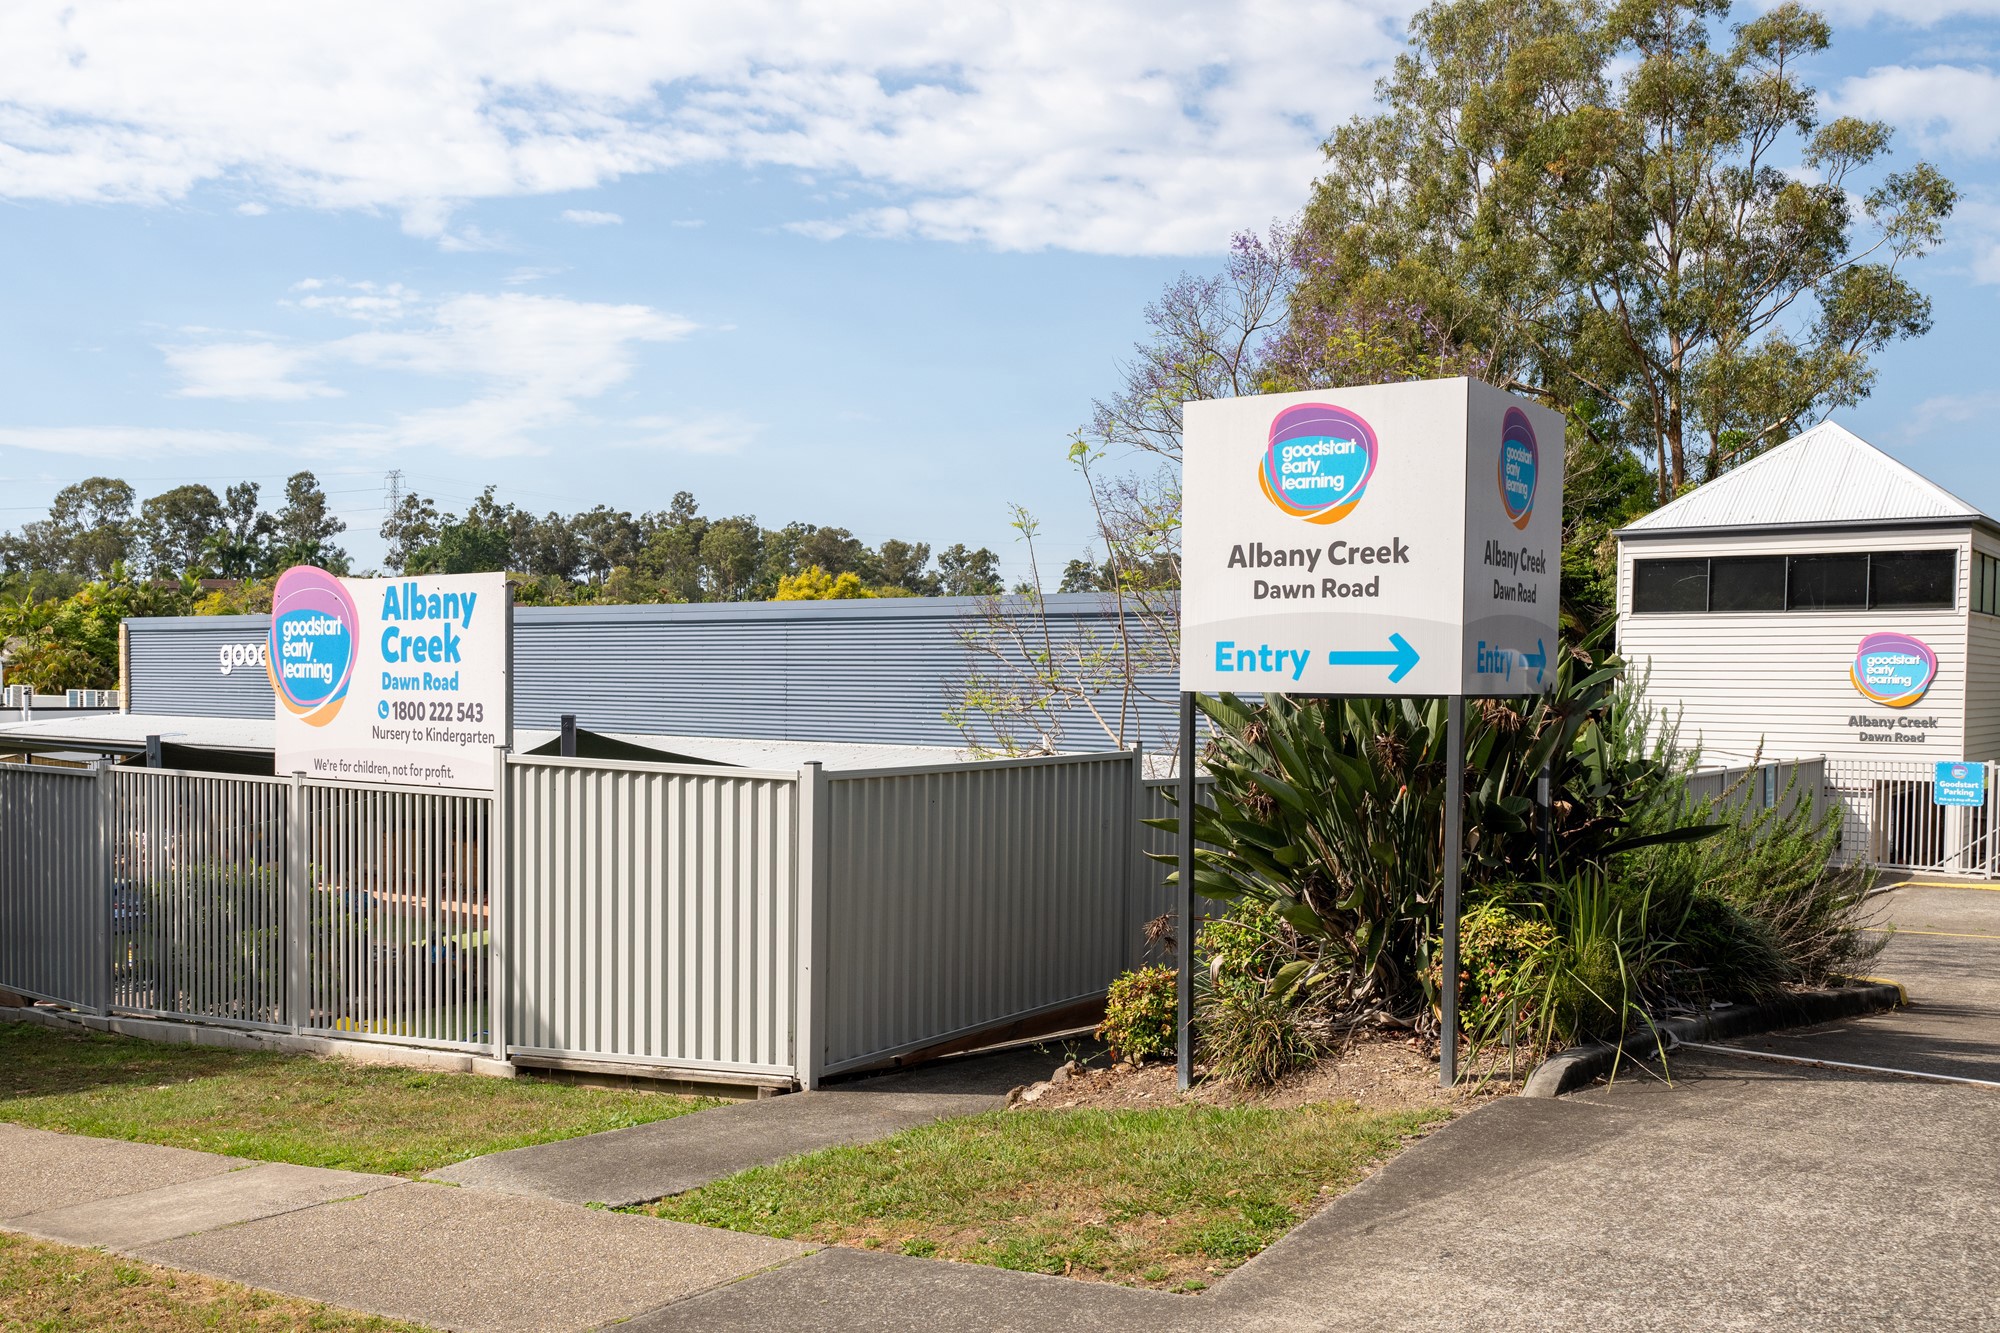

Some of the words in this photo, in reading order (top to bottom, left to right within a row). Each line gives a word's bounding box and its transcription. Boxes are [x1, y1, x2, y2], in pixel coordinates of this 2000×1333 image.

[1282, 438, 1356, 461] goodstart
[1506, 446, 1533, 465] goodstart
[1281, 458, 1320, 475] early
[1506, 462, 1521, 479] early
[1281, 473, 1344, 491] learning
[1505, 476, 1528, 499] learning
[1227, 542, 1322, 573] Albany
[1327, 537, 1410, 565] Creek
[1484, 539, 1519, 576] Albany
[1520, 547, 1546, 574] Creek
[1253, 580, 1315, 600] Dawn
[1321, 575, 1380, 599] Road
[1493, 578, 1516, 602] Dawn
[1517, 582, 1537, 604] Road
[381, 582, 477, 630] Albany
[282, 616, 342, 641] goodstart
[282, 637, 314, 662] early
[381, 622, 461, 664] Creek
[282, 658, 333, 685] learning
[1215, 641, 1311, 682] Entry
[1477, 640, 1513, 682] Entry
[1866, 655, 1920, 667] goodstart
[1866, 665, 1895, 677] early
[382, 671, 420, 691] Dawn
[423, 670, 459, 691] Road
[1866, 675, 1912, 687] learning
[392, 701, 426, 721] 1800
[429, 701, 453, 722] 222
[456, 702, 484, 723] 543
[1848, 715, 1895, 730] Albany
[1897, 716, 1938, 729] Creek
[372, 725, 411, 744] Nursery
[412, 729, 423, 741] to
[426, 727, 495, 747] Kindergarten
[1859, 732, 1892, 742] Dawn
[1894, 732, 1926, 743] Road
[314, 758, 338, 772] We’re
[339, 759, 352, 772] for
[353, 760, 391, 778] children,
[392, 763, 408, 776] not
[409, 763, 424, 777] for
[425, 765, 454, 780] profit.
[1939, 780, 1979, 789] Goodstart
[1943, 788, 1975, 798] Parking
